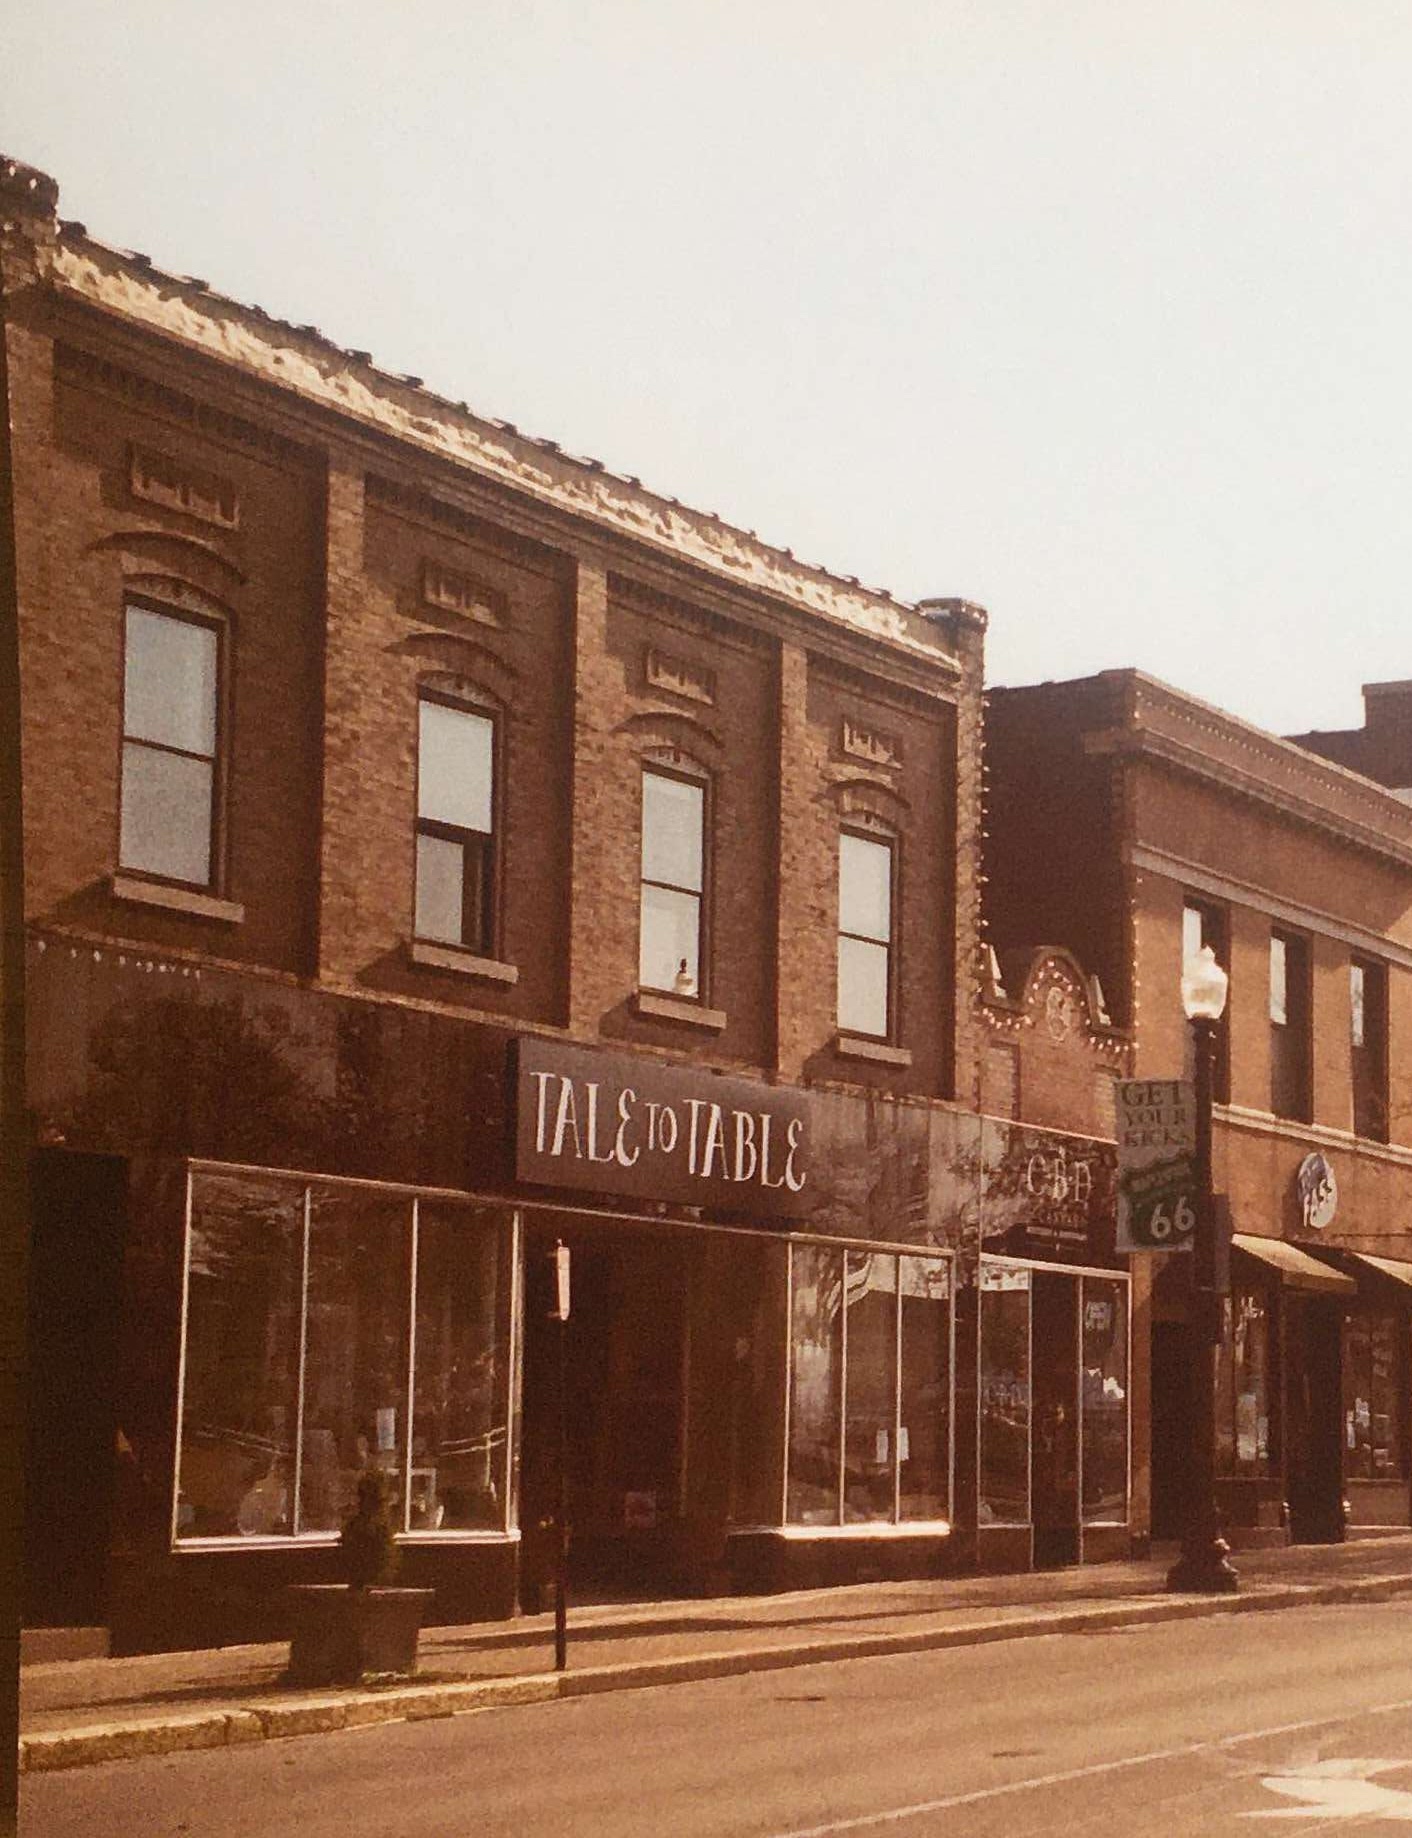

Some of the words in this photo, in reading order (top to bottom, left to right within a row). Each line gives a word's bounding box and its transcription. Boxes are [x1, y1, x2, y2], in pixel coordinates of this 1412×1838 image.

[1121, 1083, 1183, 1106] GET
[529, 1072, 640, 1167] TALE
[645, 1102, 678, 1153] TO
[683, 1099, 807, 1192] TABLE
[1123, 1108, 1187, 1127] YOUR
[1150, 1195, 1195, 1239] 66
